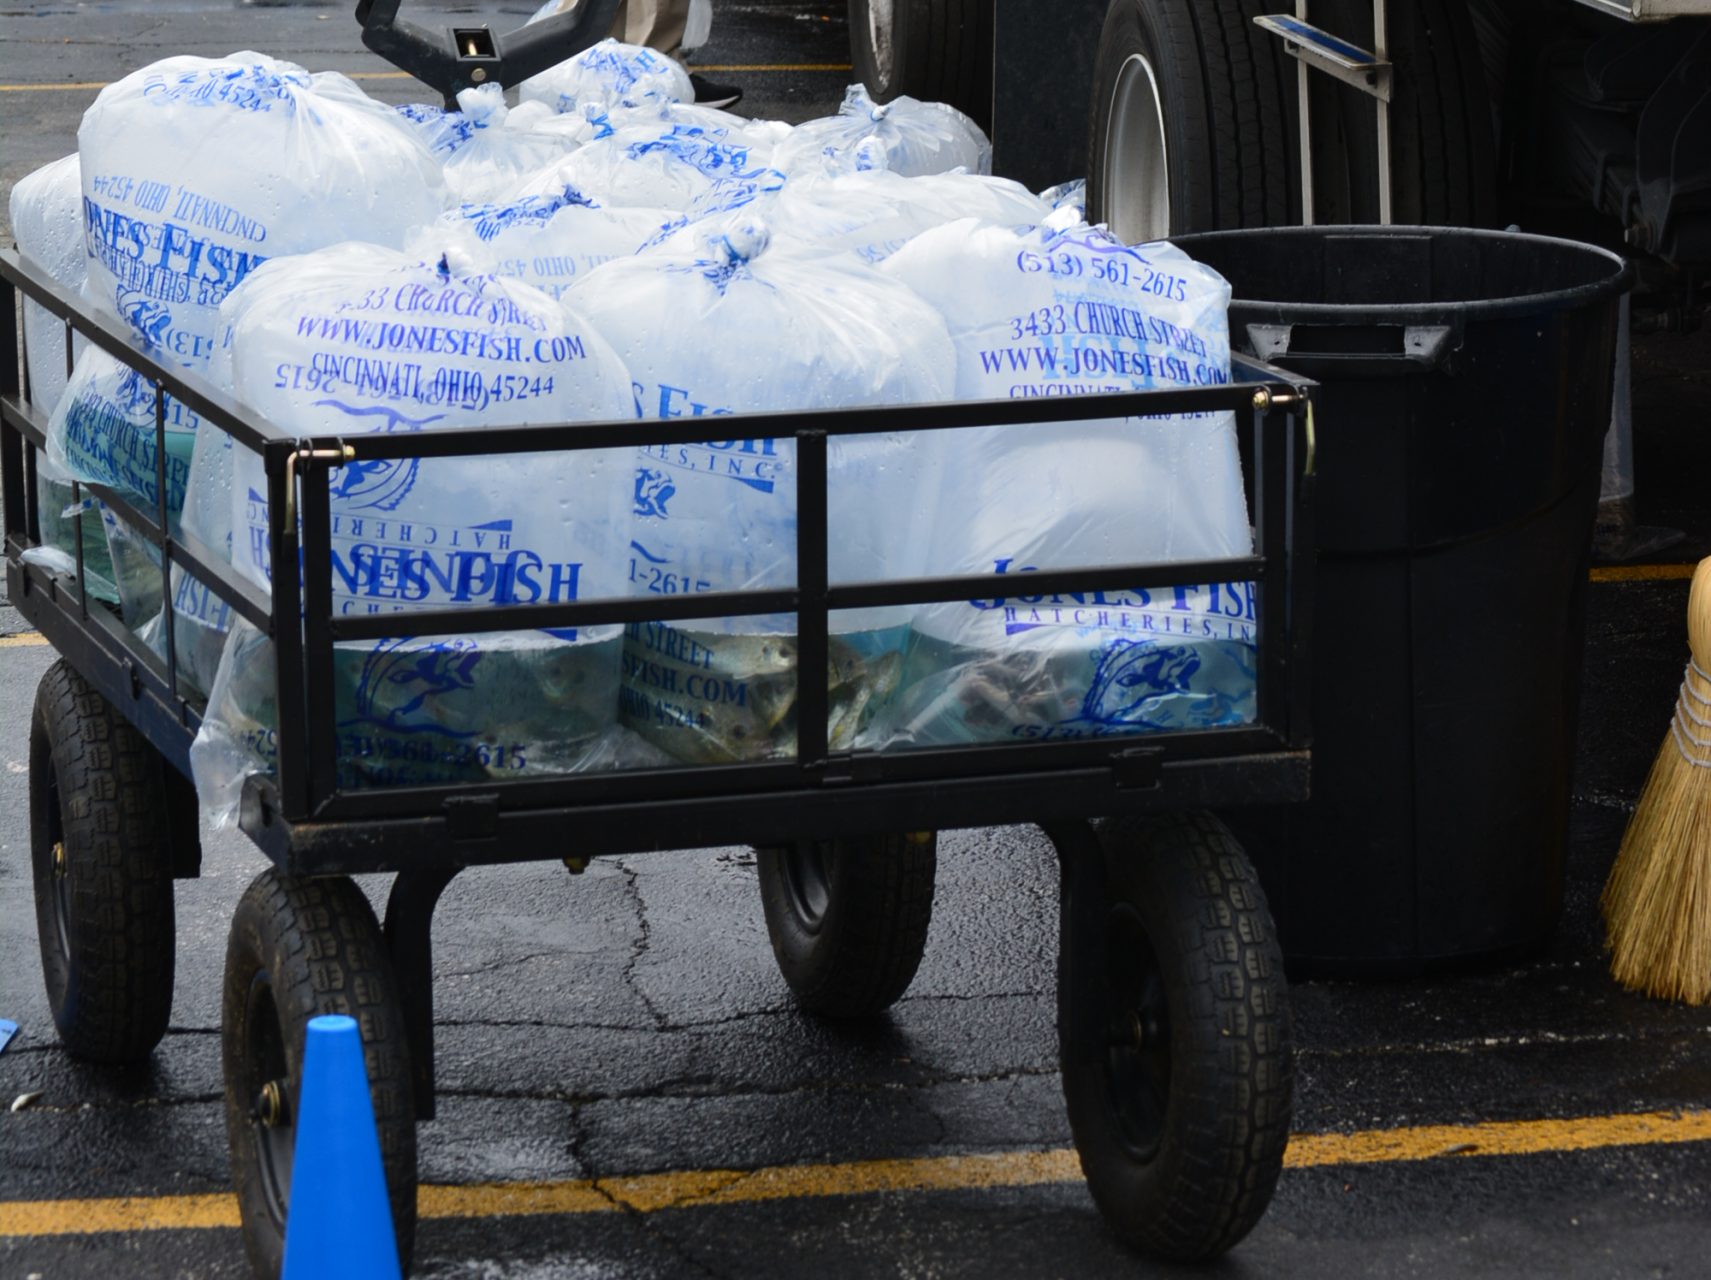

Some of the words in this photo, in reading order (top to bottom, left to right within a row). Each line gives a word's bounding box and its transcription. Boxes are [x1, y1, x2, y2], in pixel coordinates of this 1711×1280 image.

[93, 174, 134, 203] 45244
[134, 178, 171, 213] OHIO
[174, 184, 267, 244] CINCINNATI,
[532, 255, 577, 277] OHIO
[1016, 249, 1084, 277] (513)
[1090, 256, 1187, 302] 561-2615
[393, 283, 484, 318] CHURCH
[1010, 303, 1068, 341] 3433
[1073, 300, 1149, 342] CHURCH
[296, 315, 588, 364] WWW.JONESFISH.COM
[312, 352, 425, 404] CINCINNATI,
[434, 366, 484, 403] OHIO
[490, 375, 555, 403] 45244
[1004, 605, 1219, 640] HATCHERIES,
[645, 619, 715, 670] STREET
